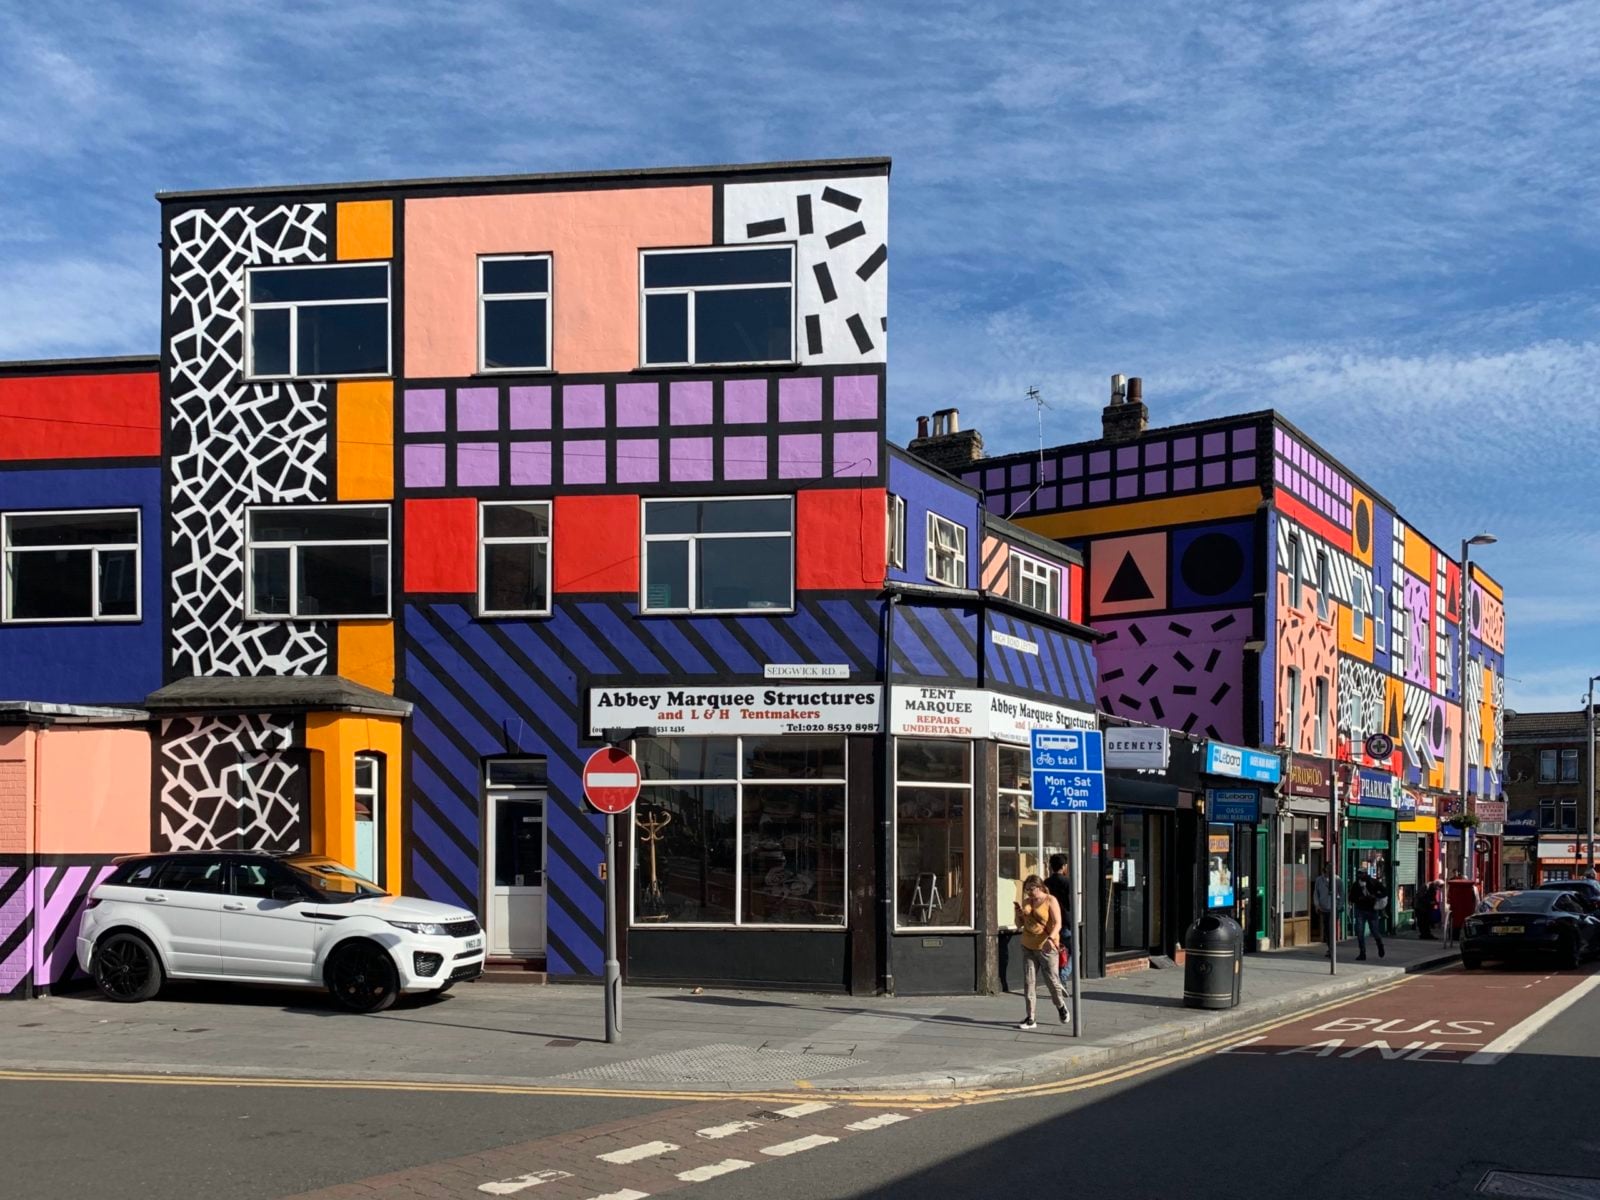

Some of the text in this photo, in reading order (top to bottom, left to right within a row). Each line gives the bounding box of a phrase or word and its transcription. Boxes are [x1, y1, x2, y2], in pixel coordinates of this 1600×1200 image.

[767, 666, 818, 676] SEDGWICK
[821, 666, 836, 676] RD
[597, 690, 875, 710] Abbey Marquee Structures
[920, 688, 956, 700] TENT
[905, 700, 973, 714] MARQUEE
[657, 708, 821, 720] and L & H Tentmakers
[990, 697, 1018, 718] Abbey
[1019, 703, 1053, 723] Marquee
[1056, 710, 1095, 730] Structures
[916, 715, 960, 725] REPAIRS
[786, 723, 880, 732] Tel:020 8539 8987
[902, 724, 973, 735] UNDERTAKEN
[1108, 741, 1162, 750] DEENEY'S
[1057, 755, 1077, 765] taxi
[1219, 748, 1241, 767] Lebara
[1044, 775, 1066, 786] Mon
[1073, 776, 1092, 787] Sat
[1048, 786, 1056, 796] 7
[1063, 786, 1089, 797] 10am
[1050, 796, 1059, 807] 4
[1066, 797, 1088, 809] 7pm
[1311, 1016, 1495, 1035] BUS
[1216, 1036, 1485, 1065] LANE
